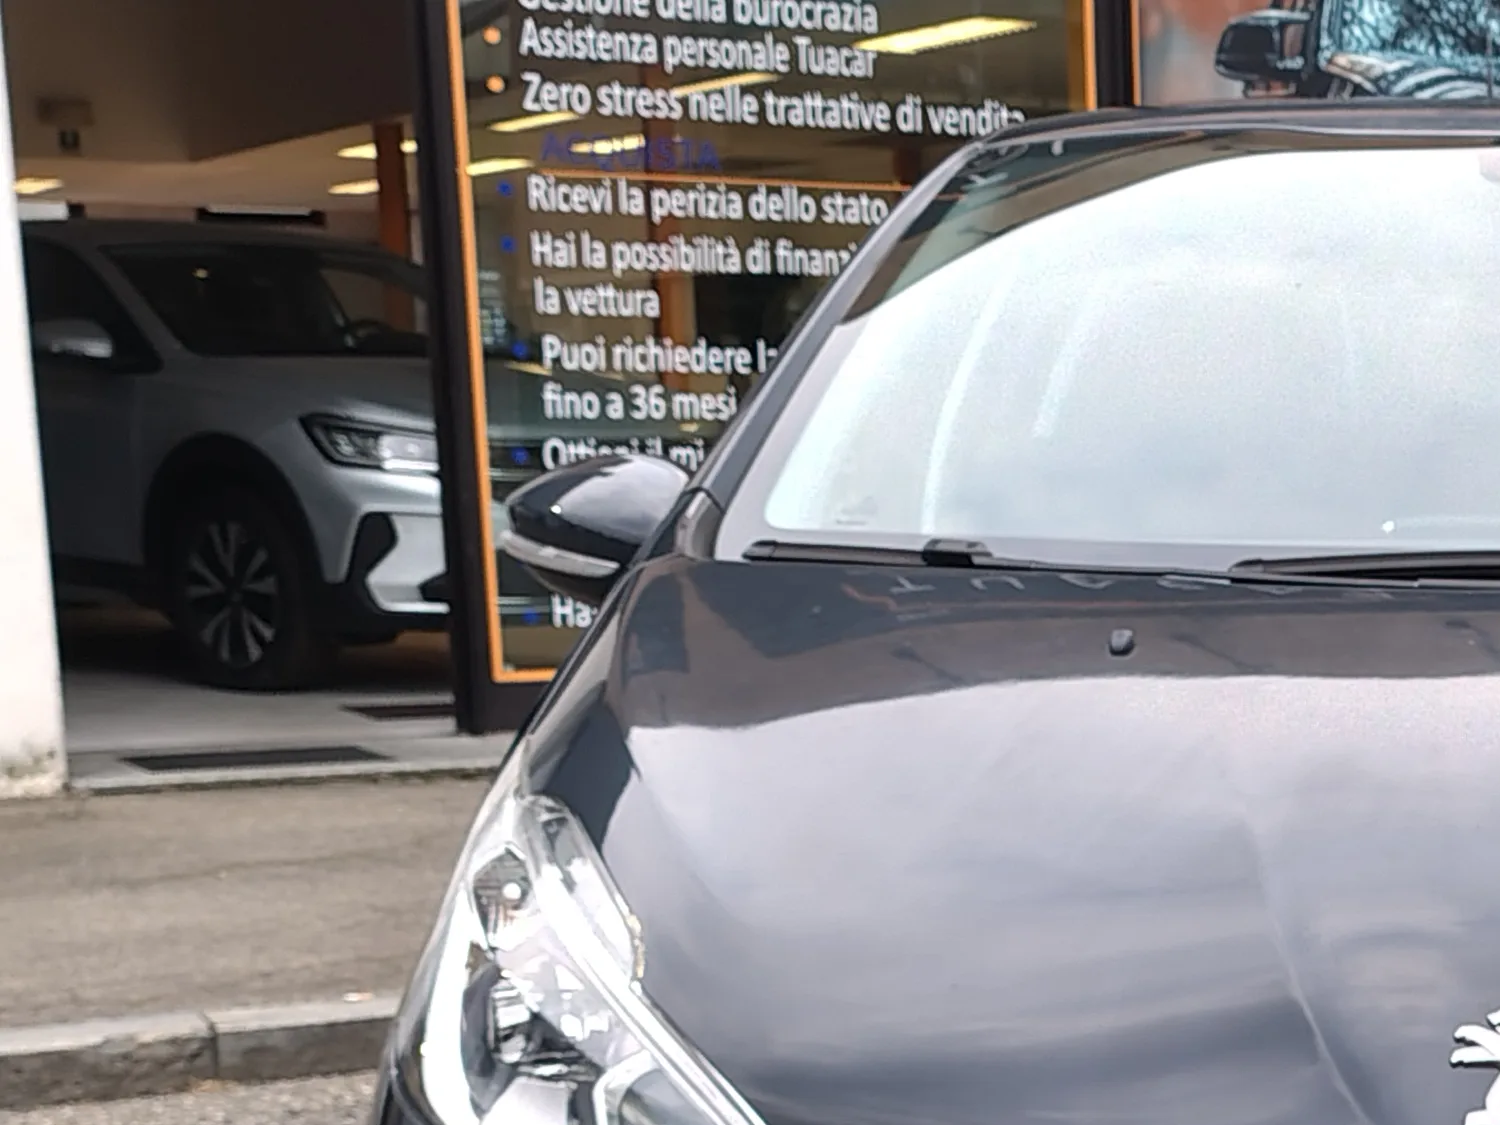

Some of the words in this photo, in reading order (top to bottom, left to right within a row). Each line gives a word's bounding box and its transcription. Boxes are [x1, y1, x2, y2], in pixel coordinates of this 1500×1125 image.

[656, 0, 726, 23] della
[733, 0, 878, 34] burocrazia
[519, 16, 657, 64] Assistenza
[662, 32, 790, 74] personale
[792, 35, 877, 78] Tuacar
[520, 71, 592, 115] Zero
[596, 80, 683, 120] stress
[688, 84, 759, 125] nelle
[764, 89, 891, 133] trattative
[896, 93, 922, 134] di
[527, 173, 613, 215] Ricevi
[617, 176, 646, 216] la
[650, 181, 743, 225] perizia
[748, 183, 817, 223] dello
[821, 191, 889, 225] stato
[529, 229, 577, 268] Hai
[580, 229, 607, 270] la
[611, 233, 742, 278] possibilità
[745, 236, 771, 276] di
[533, 276, 561, 315] la
[564, 282, 660, 318] vettura
[541, 334, 605, 372] Puoi
[612, 334, 752, 375] richiedere
[756, 338, 778, 373] l
[540, 381, 600, 420] fino
[605, 391, 624, 420] a
[628, 384, 666, 420] 36
[671, 385, 737, 422] mesi
[551, 594, 598, 628] Ha
